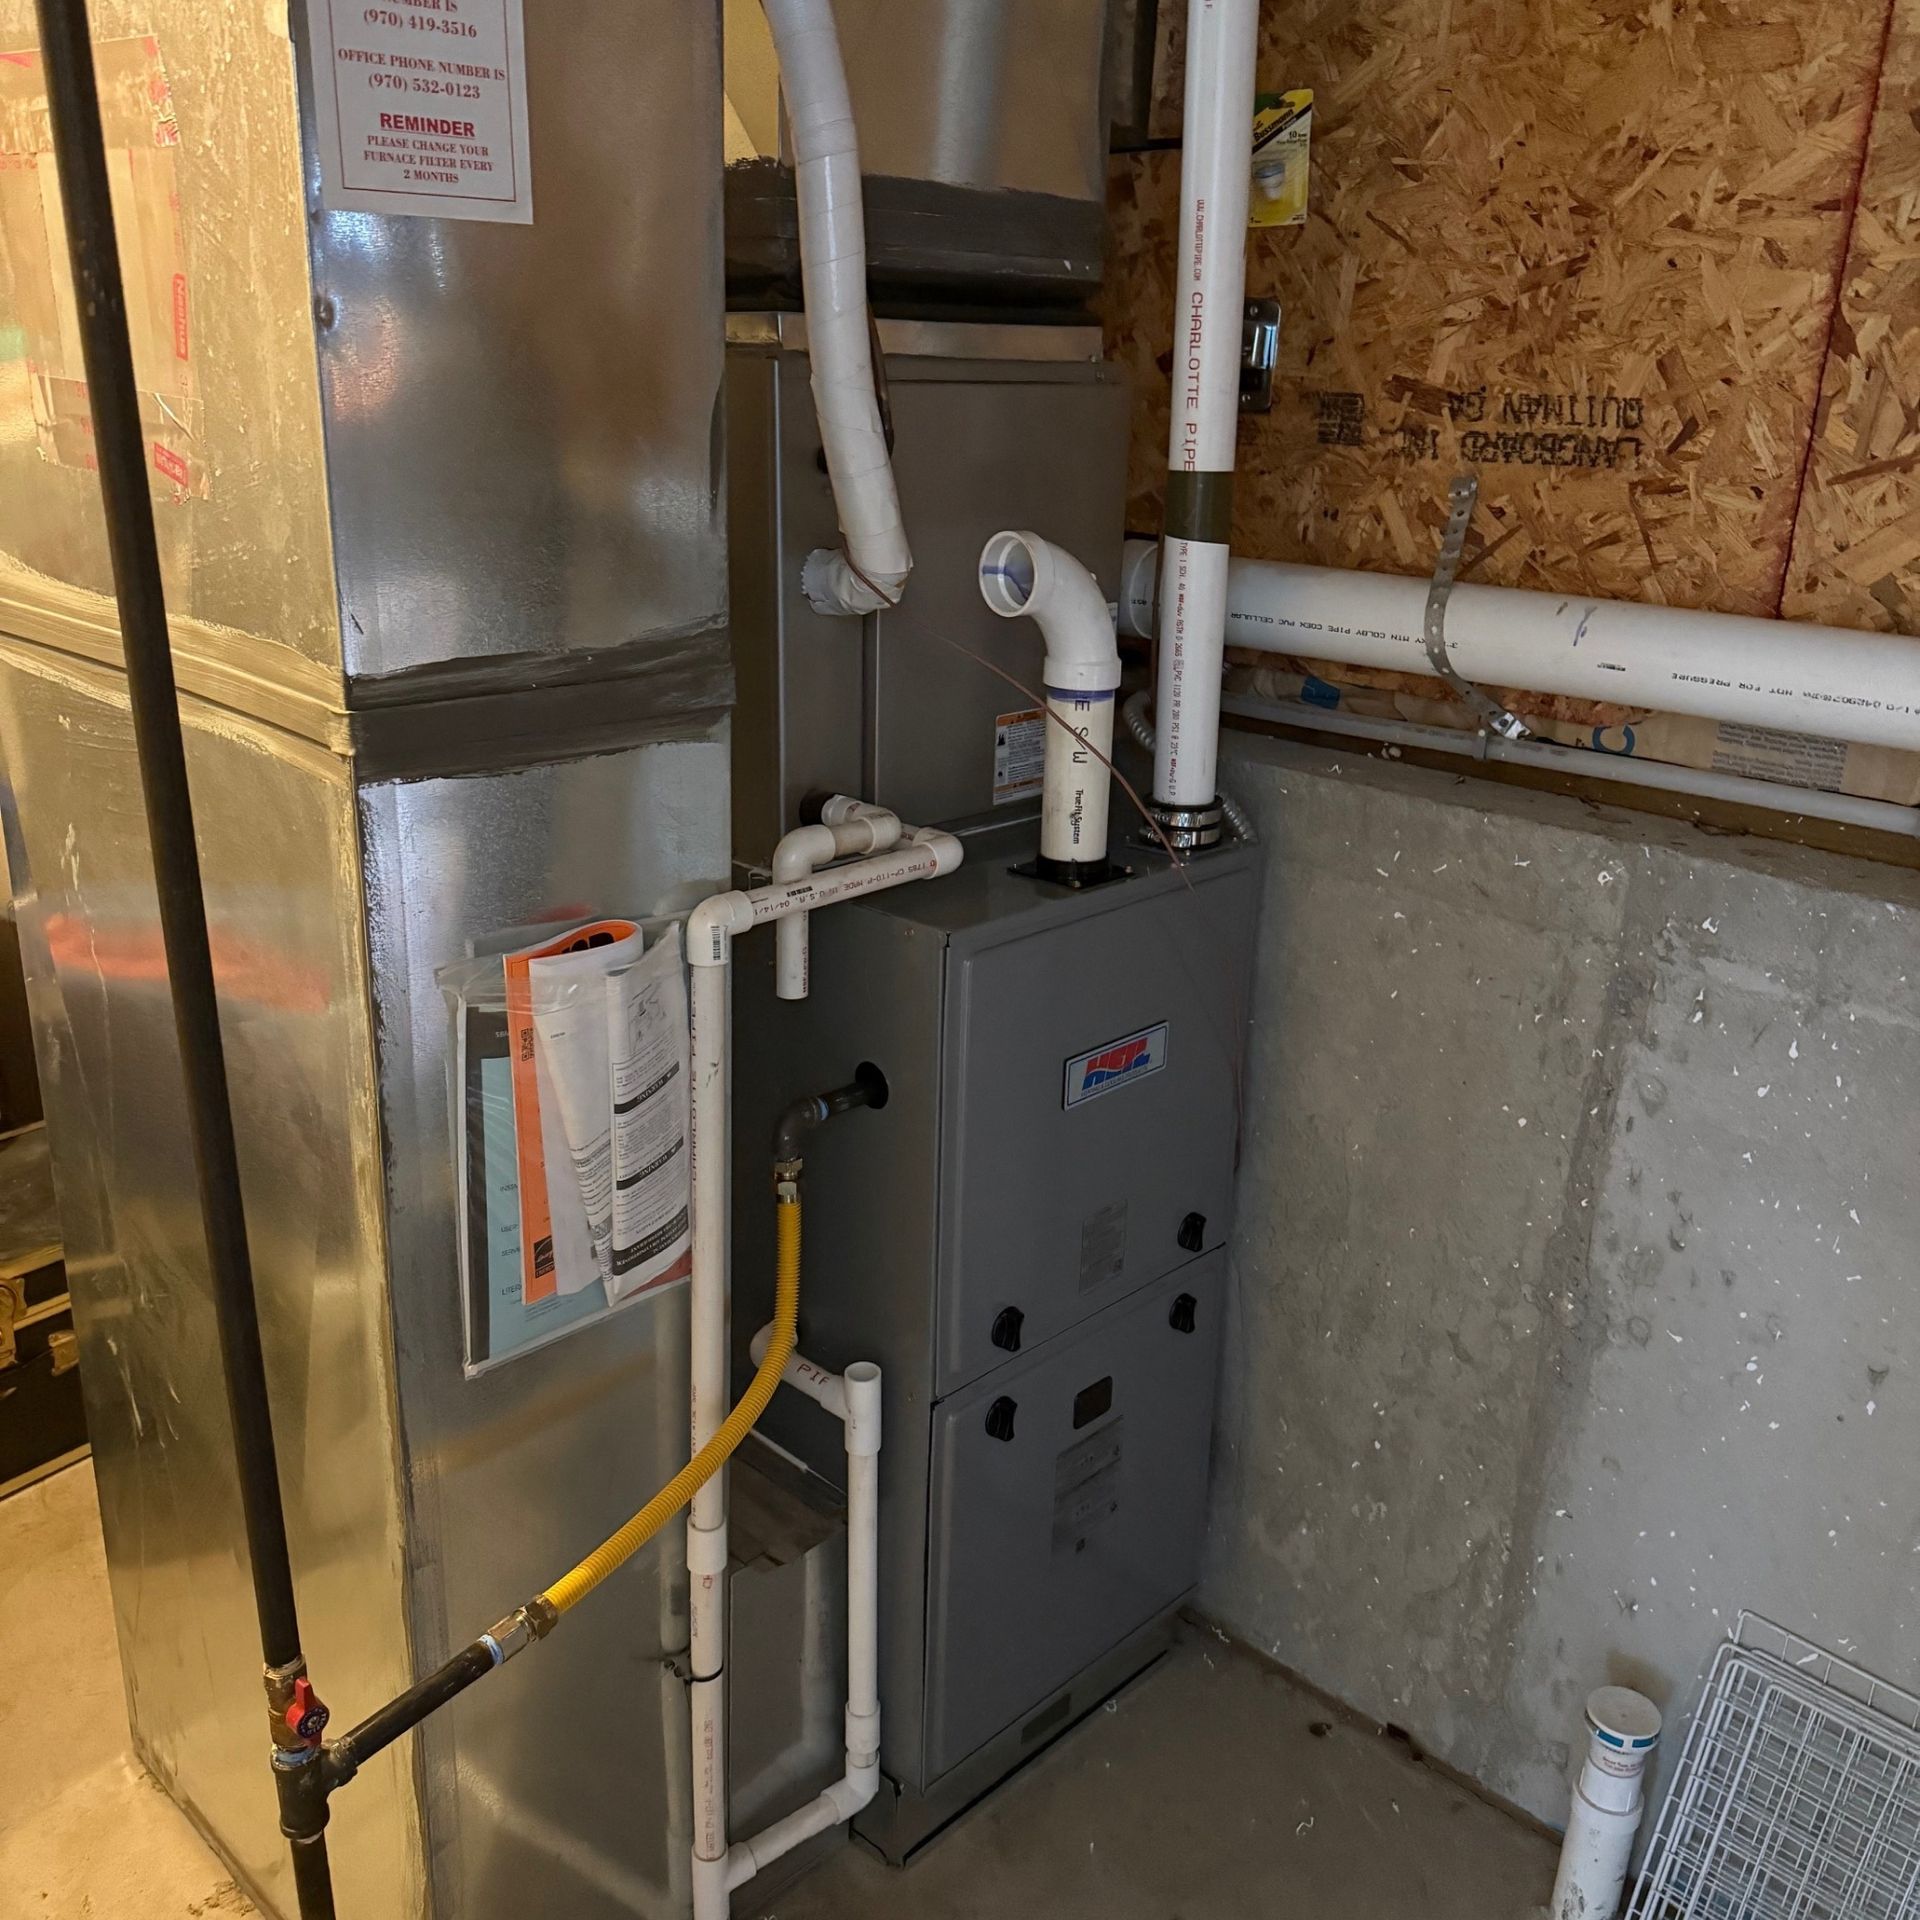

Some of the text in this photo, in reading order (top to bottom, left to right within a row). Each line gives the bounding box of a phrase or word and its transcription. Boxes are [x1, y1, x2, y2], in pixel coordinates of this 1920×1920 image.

[382, 0, 458, 12] MBER IS
[364, 9, 478, 38] (970) 419-3516
[338, 48, 506, 81] OFFICE PHONE NUMBER IS
[368, 73, 480, 100] (970) 532-0123
[380, 112, 476, 138] REMINDER
[367, 135, 489, 156] PLEASE CHANGE YOUR
[364, 150, 494, 172] FURNACE FILTER EVERY
[403, 170, 459, 184] 2 MONTHS
[1183, 199, 1205, 472] WWW.CHARLOTTEPIPE.COM CHARLOTTE PIPE
[1502, 394, 1644, 430] QUITMAN
[1179, 542, 1188, 557] TYPE
[1230, 612, 1273, 624] CELLULAR
[1278, 618, 1295, 628] PVC
[1176, 619, 1184, 634] ASTM
[1299, 622, 1322, 631] COEX
[1328, 625, 1351, 636] PIPE
[1356, 629, 1386, 640] COLBY
[1390, 634, 1410, 642] MTN
[1174, 642, 1183, 658] 2665
[1174, 670, 1182, 682] PVC
[1670, 671, 1731, 688] PRESSURE
[1738, 682, 1761, 692] FOR
[1768, 687, 1794, 697] NOT
[1172, 722, 1180, 732] PSI
[1070, 816, 1082, 844] System
[844, 880, 863, 891] MADE
[752, 900, 790, 917] 04/14/1
